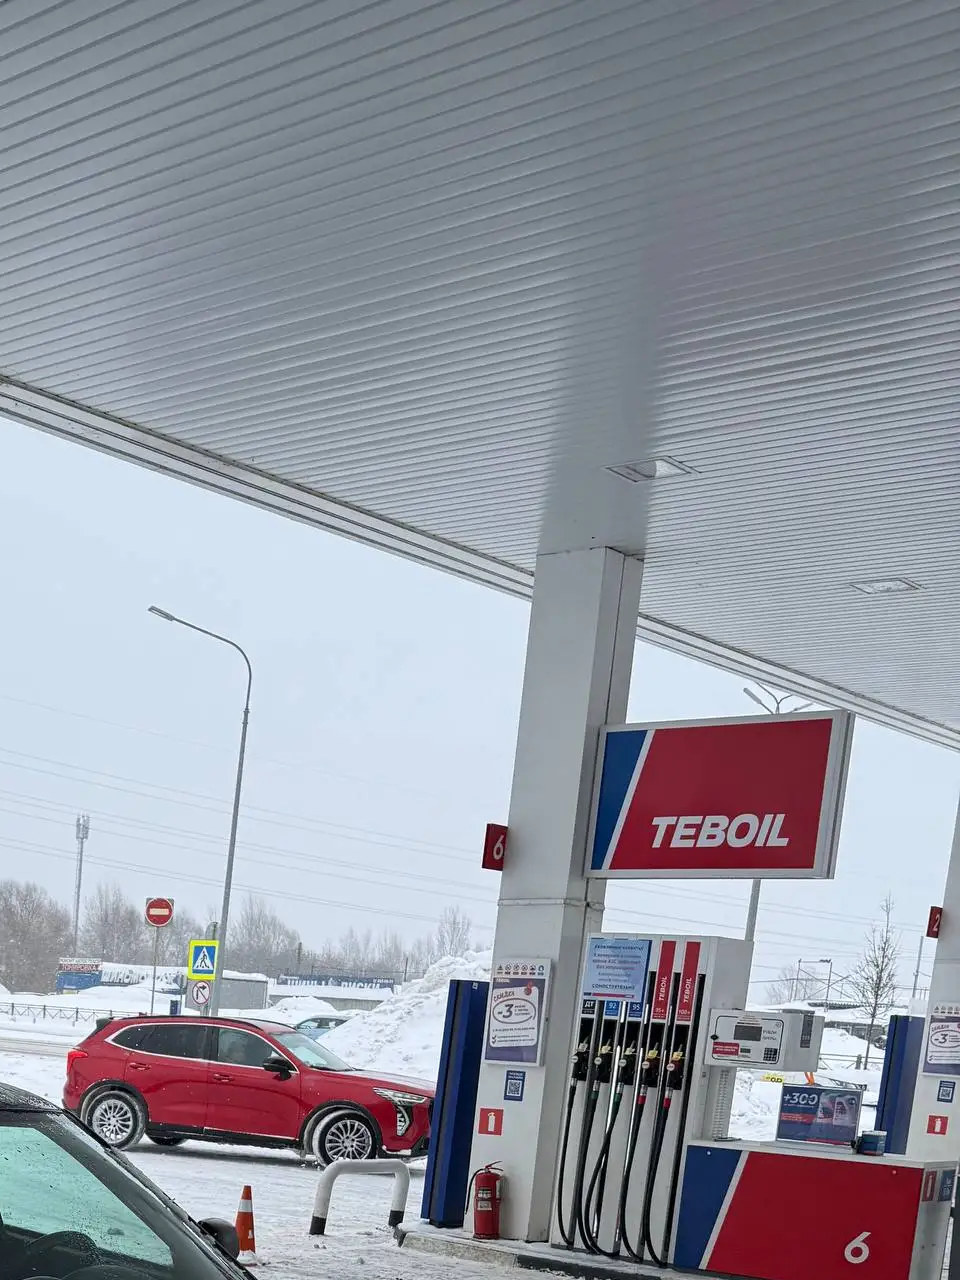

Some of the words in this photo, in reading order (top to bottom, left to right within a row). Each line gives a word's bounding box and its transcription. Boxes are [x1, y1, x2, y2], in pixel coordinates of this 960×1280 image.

[651, 813, 790, 849] TEBOIL
[493, 834, 505, 861] 6
[932, 914, 941, 932] 2
[632, 1003, 640, 1011] 95
[844, 1231, 872, 1264] 6
